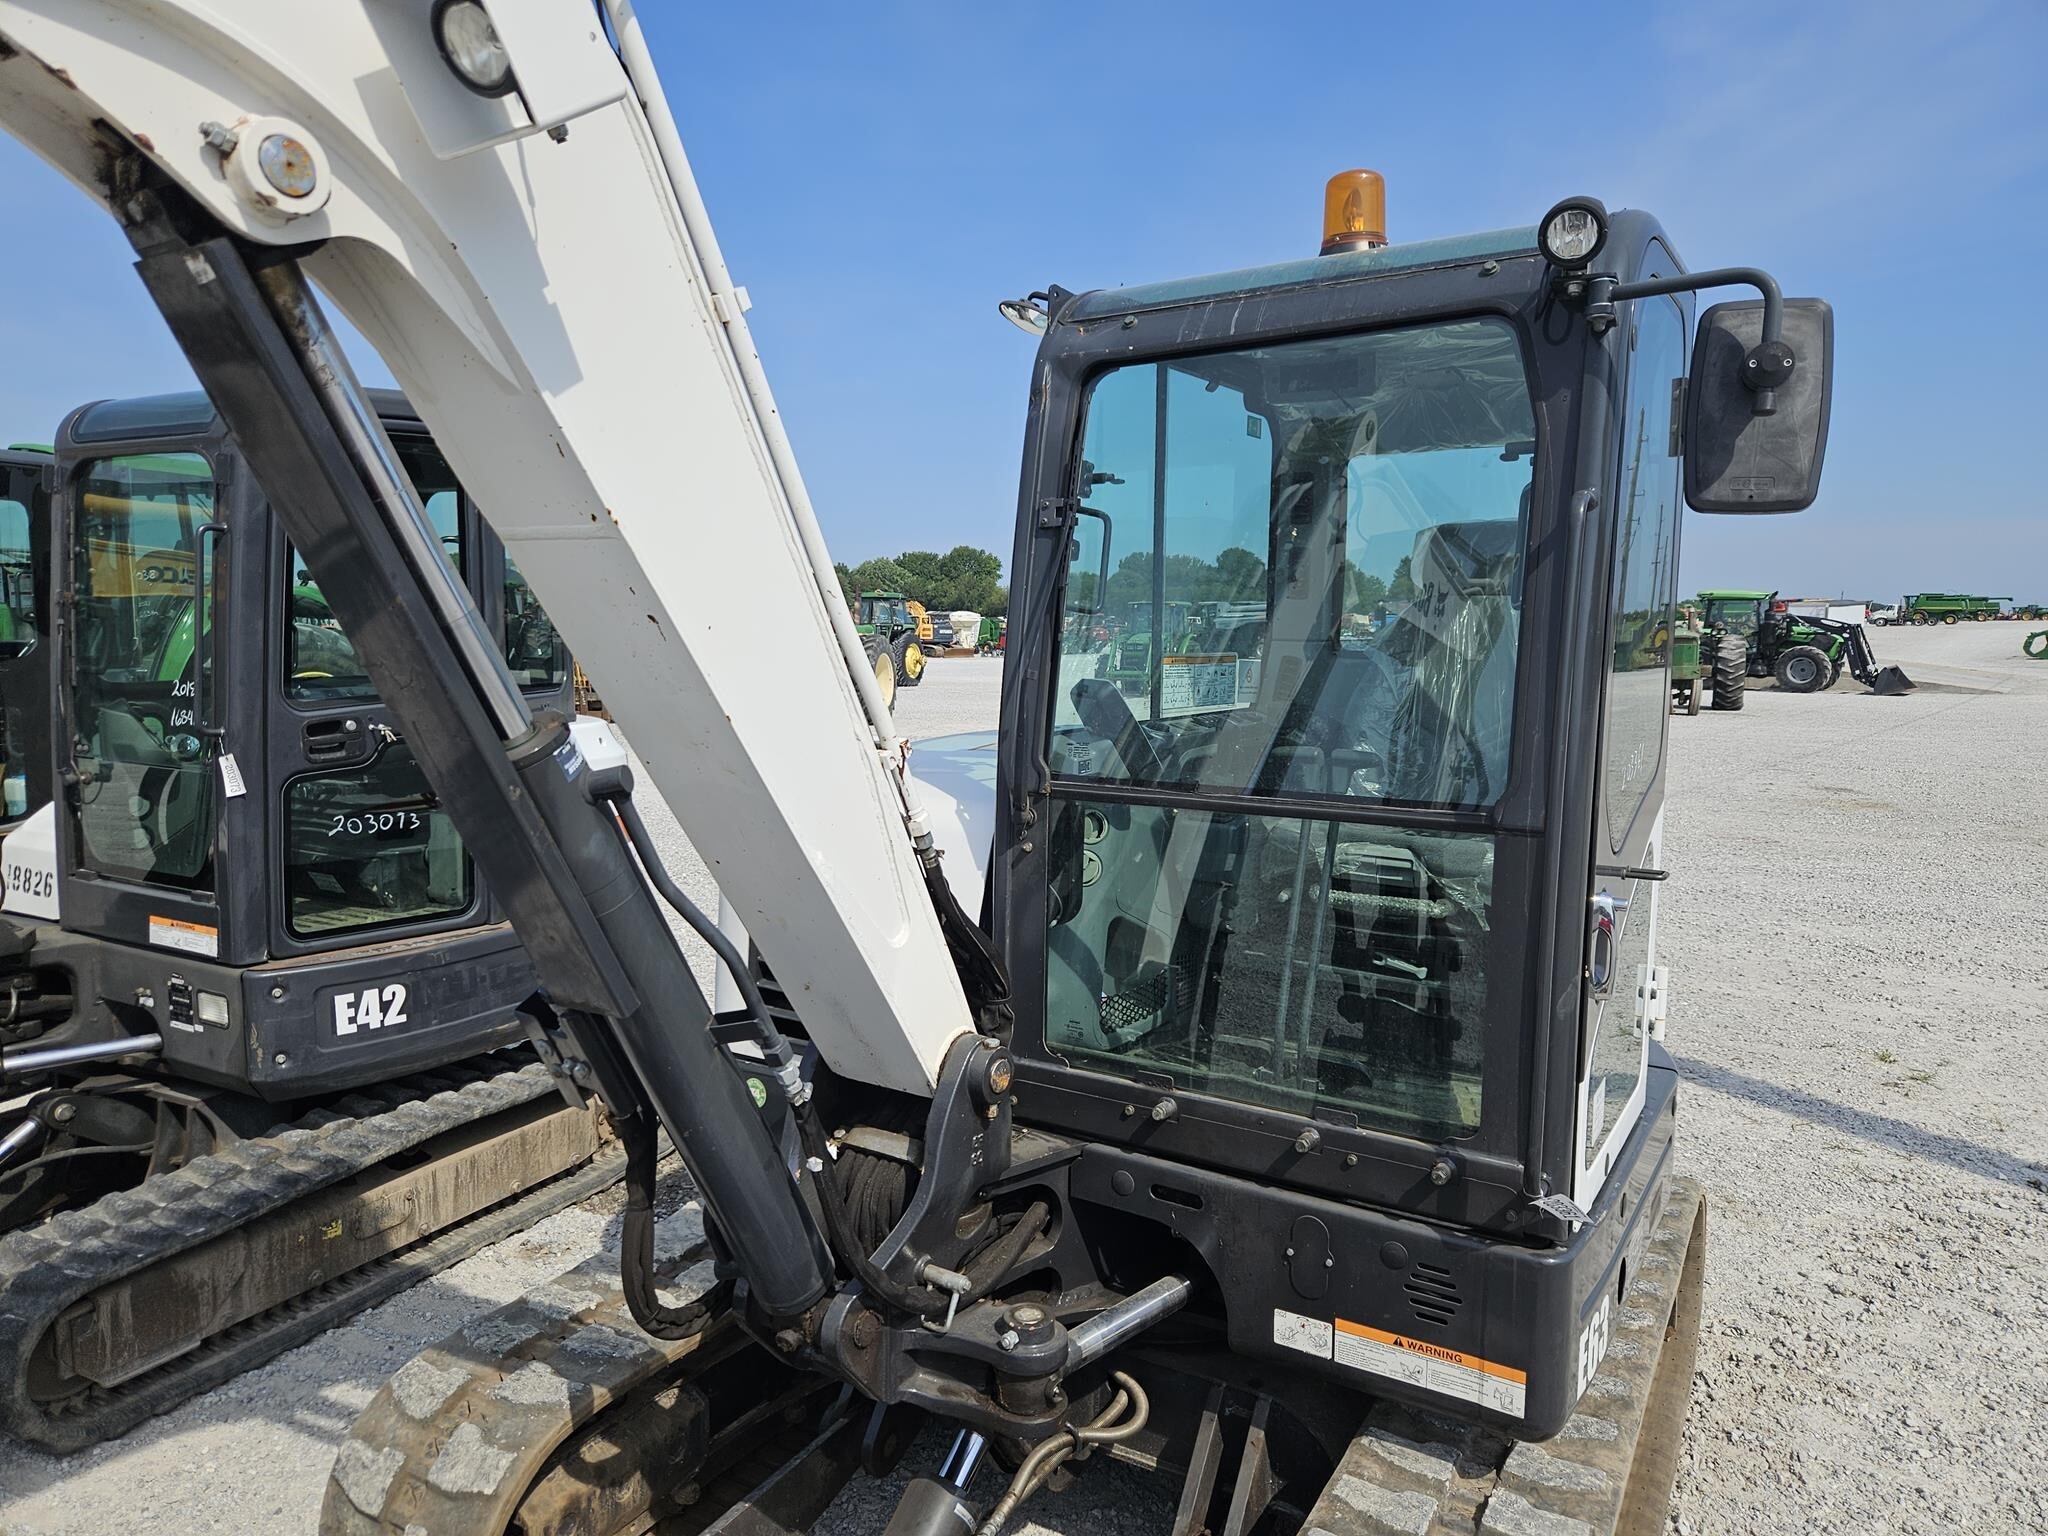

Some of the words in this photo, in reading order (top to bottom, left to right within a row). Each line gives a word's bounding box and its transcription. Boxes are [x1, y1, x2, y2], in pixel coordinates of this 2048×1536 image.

[328, 812, 420, 837] 203073
[334, 983, 408, 1036] E42
[1407, 1340, 1463, 1363] WARNING
[1577, 1294, 1609, 1401] E63
